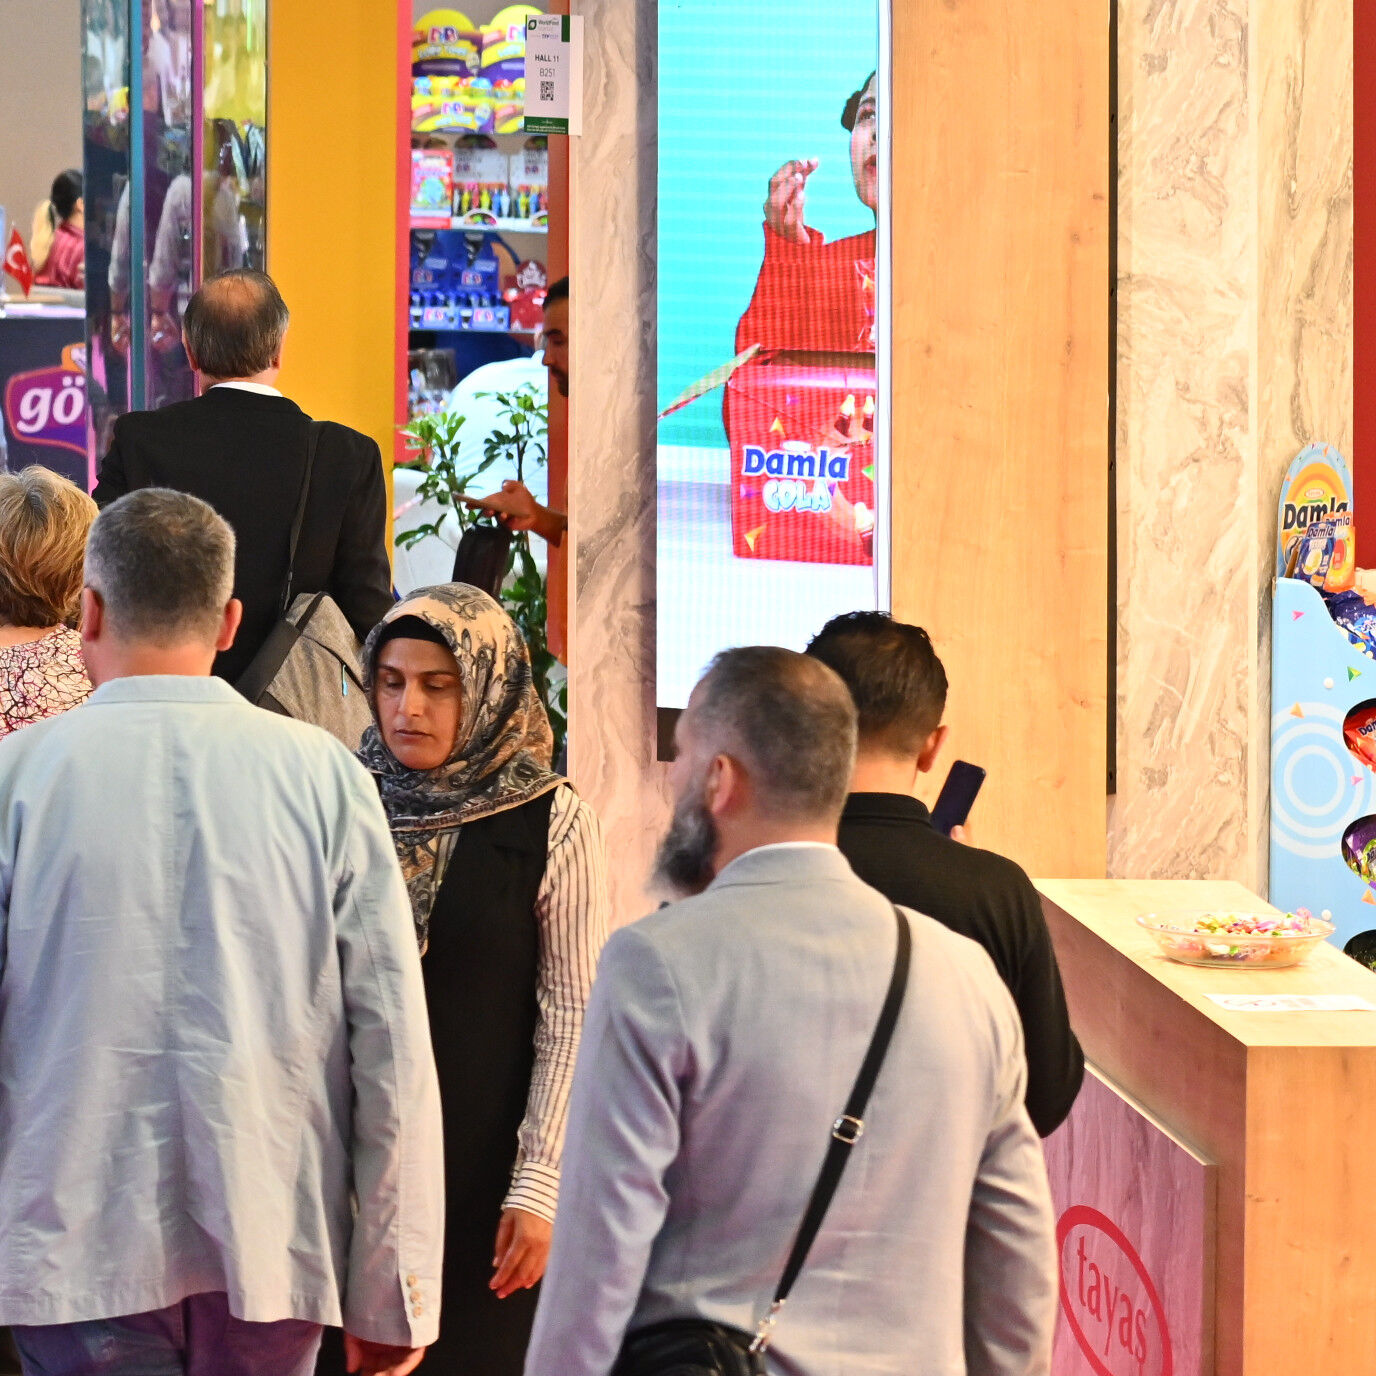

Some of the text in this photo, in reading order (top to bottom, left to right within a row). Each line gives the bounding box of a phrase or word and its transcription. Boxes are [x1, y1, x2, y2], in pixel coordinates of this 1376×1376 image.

[535, 54, 551, 62] HALL
[744, 447, 849, 479] Damla
[762, 479, 832, 513] COLA
[1282, 497, 1349, 531] Damla
